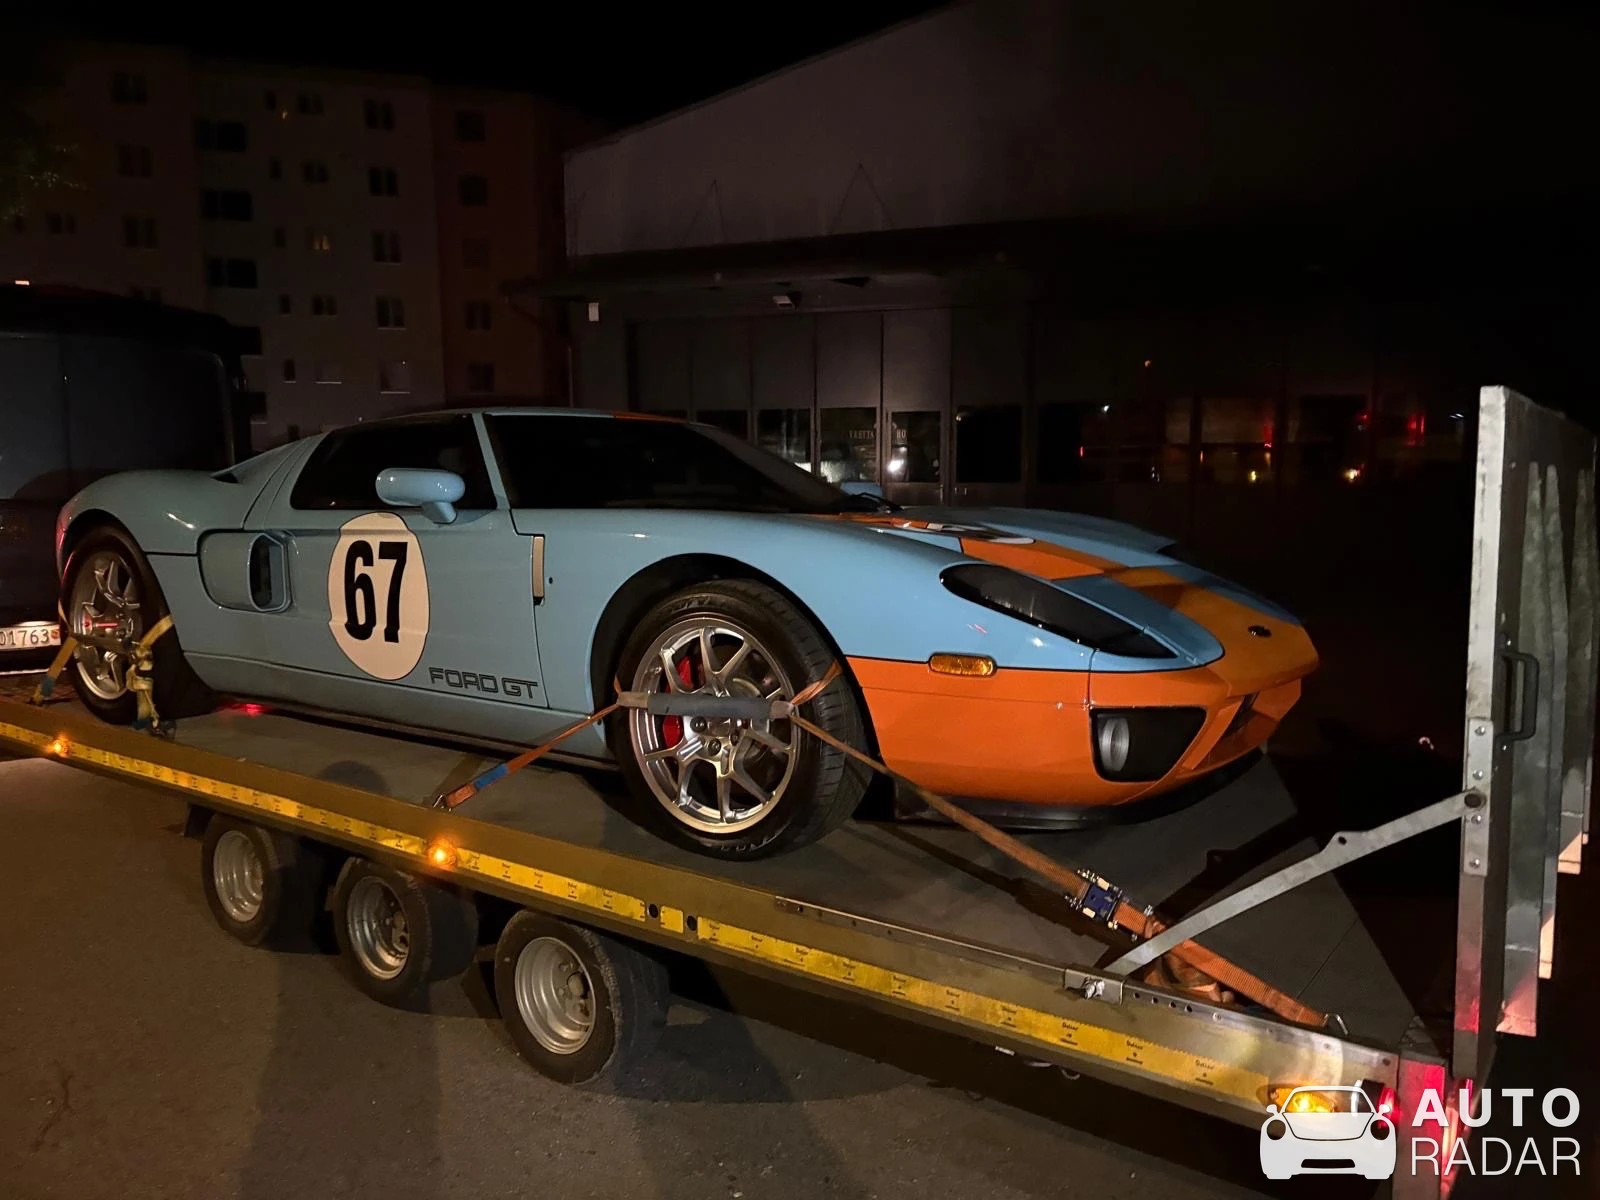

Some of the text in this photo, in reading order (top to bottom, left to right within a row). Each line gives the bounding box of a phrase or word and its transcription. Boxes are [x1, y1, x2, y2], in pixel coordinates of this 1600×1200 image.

[344, 540, 408, 643] 67
[429, 667, 538, 699] FORD GT
